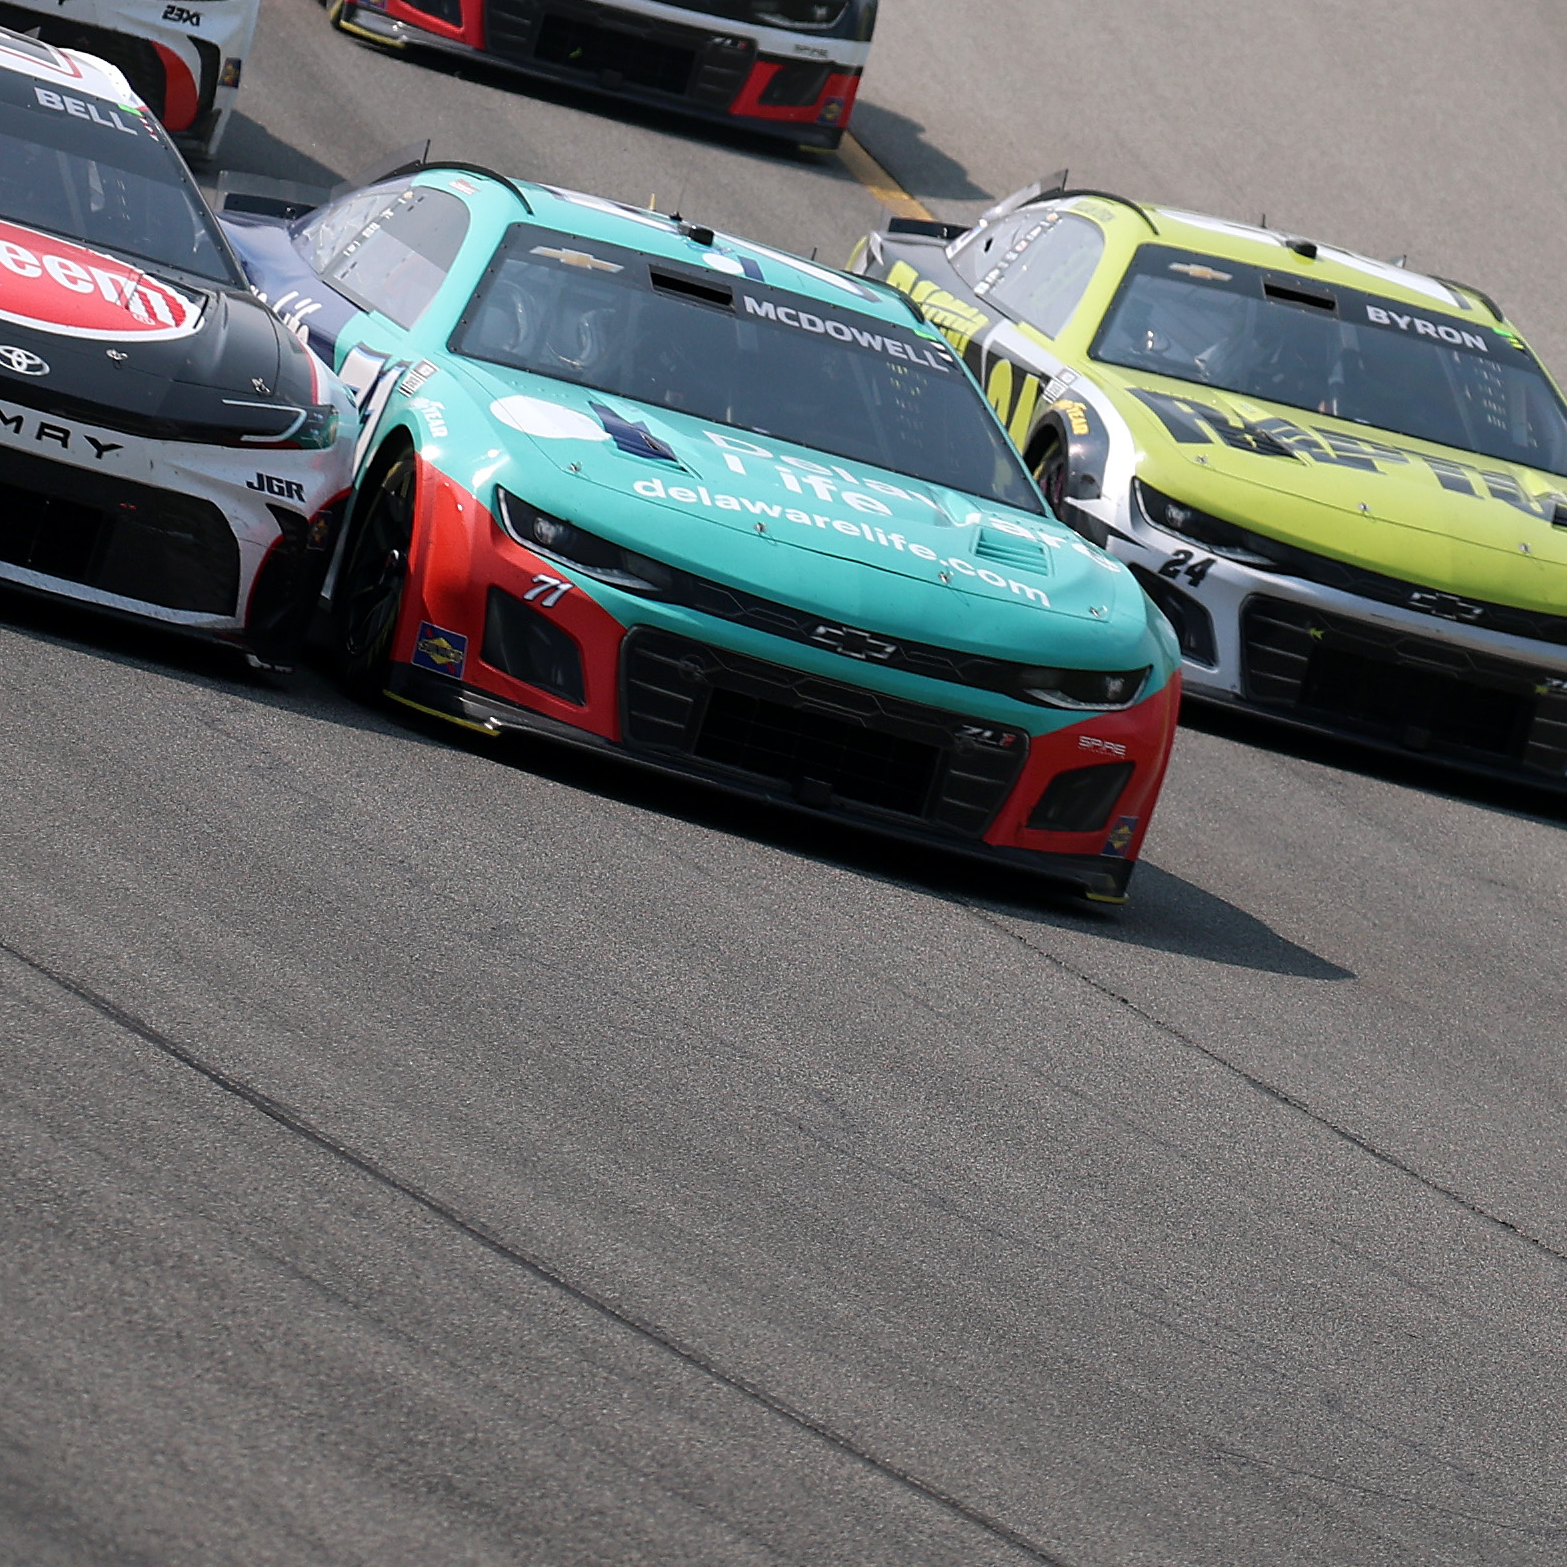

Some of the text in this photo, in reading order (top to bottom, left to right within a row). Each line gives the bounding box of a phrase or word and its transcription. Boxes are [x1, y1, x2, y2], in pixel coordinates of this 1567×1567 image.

[33, 86, 138, 136] BELL
[743, 293, 950, 374] MCDOWELL
[1364, 302, 1490, 353] BYRON
[245, 472, 307, 504] JGR
[722, 452, 894, 518] Life
[632, 477, 1053, 609] delawarelife.com
[1157, 548, 1216, 588] 24
[522, 573, 573, 609] 71
[1077, 735, 1127, 756] SPIRE
